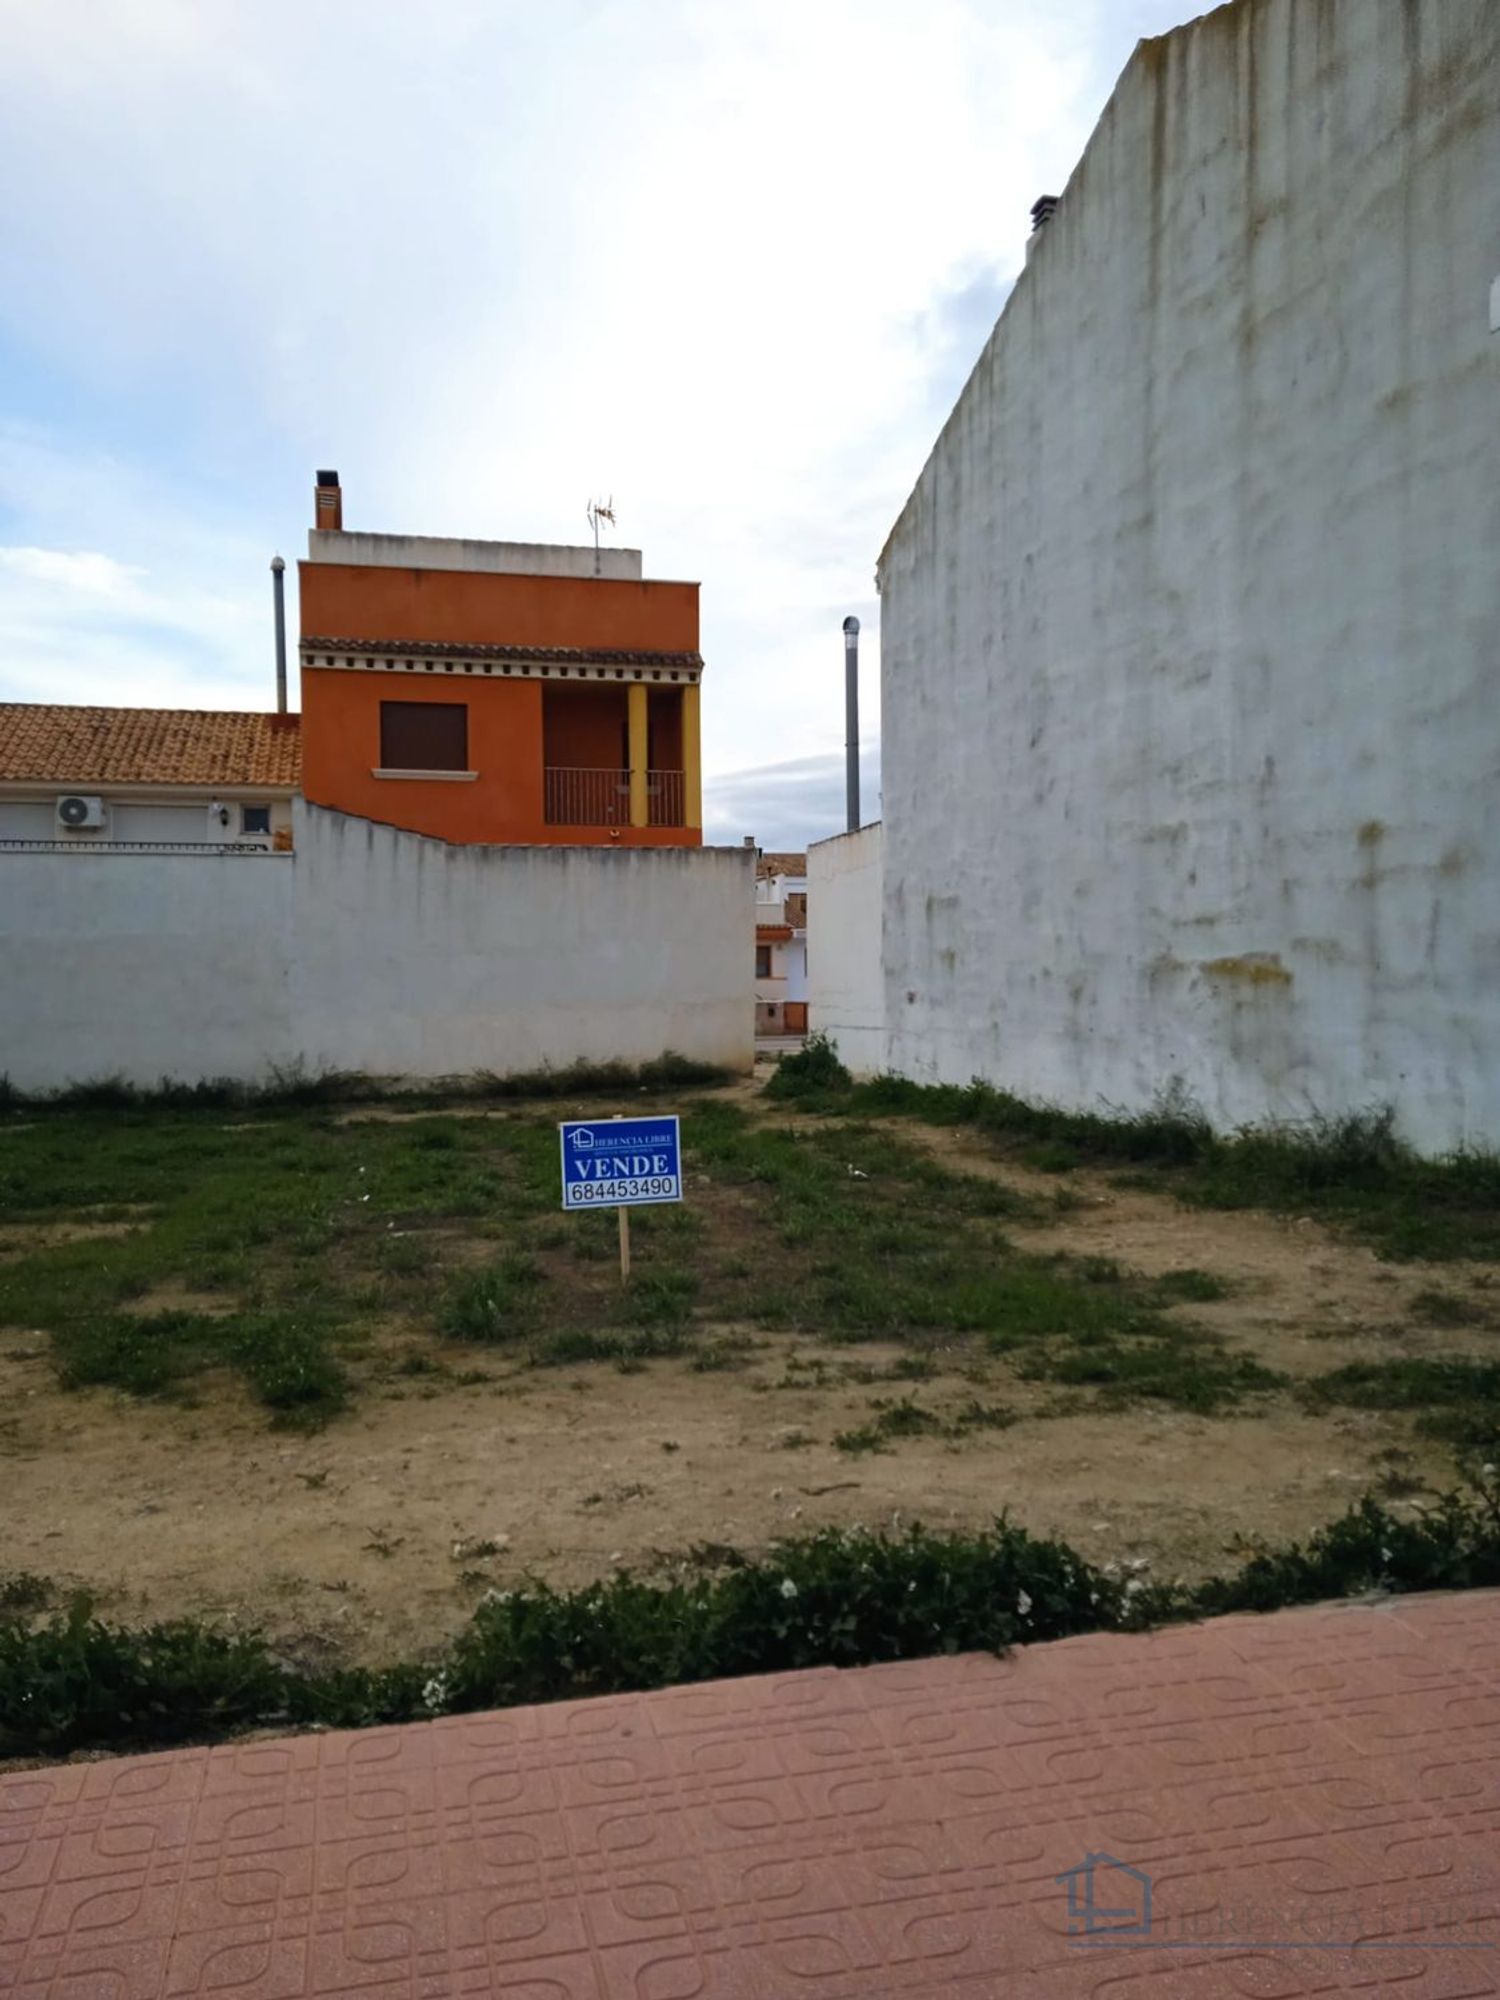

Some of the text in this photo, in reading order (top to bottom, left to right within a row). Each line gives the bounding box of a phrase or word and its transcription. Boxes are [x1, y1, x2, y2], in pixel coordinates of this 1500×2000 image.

[594, 1136, 643, 1147] HERENCIA
[574, 1154, 669, 1179] VENDE
[572, 1178, 672, 1201] 684453490
